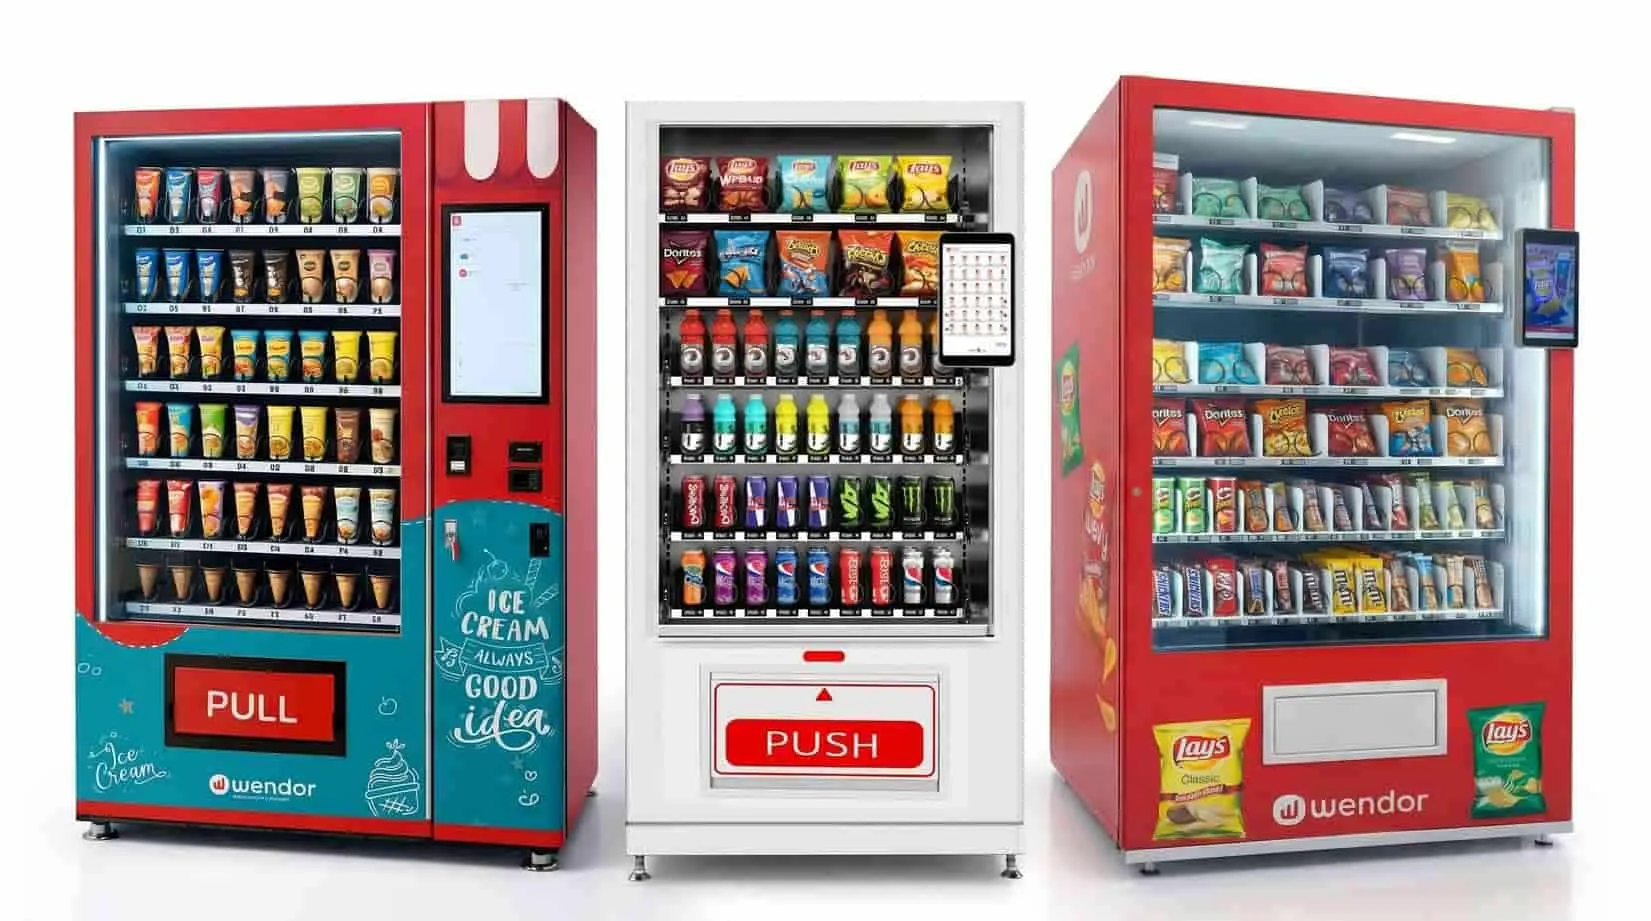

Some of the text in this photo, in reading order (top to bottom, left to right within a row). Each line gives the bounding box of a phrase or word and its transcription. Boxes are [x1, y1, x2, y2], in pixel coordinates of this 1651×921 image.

[1152, 408, 1182, 418] oritos
[487, 589, 526, 615] ICE
[460, 611, 550, 642] CREAM
[474, 649, 534, 668] ALWAYS
[465, 673, 538, 701] GOOD
[206, 689, 299, 725] PULL
[454, 699, 551, 751] idea
[92, 742, 138, 770] Ice
[766, 730, 879, 760] PUSH
[95, 762, 168, 791] Cream
[231, 777, 318, 798] wendor
[1310, 790, 1429, 819] wendor
